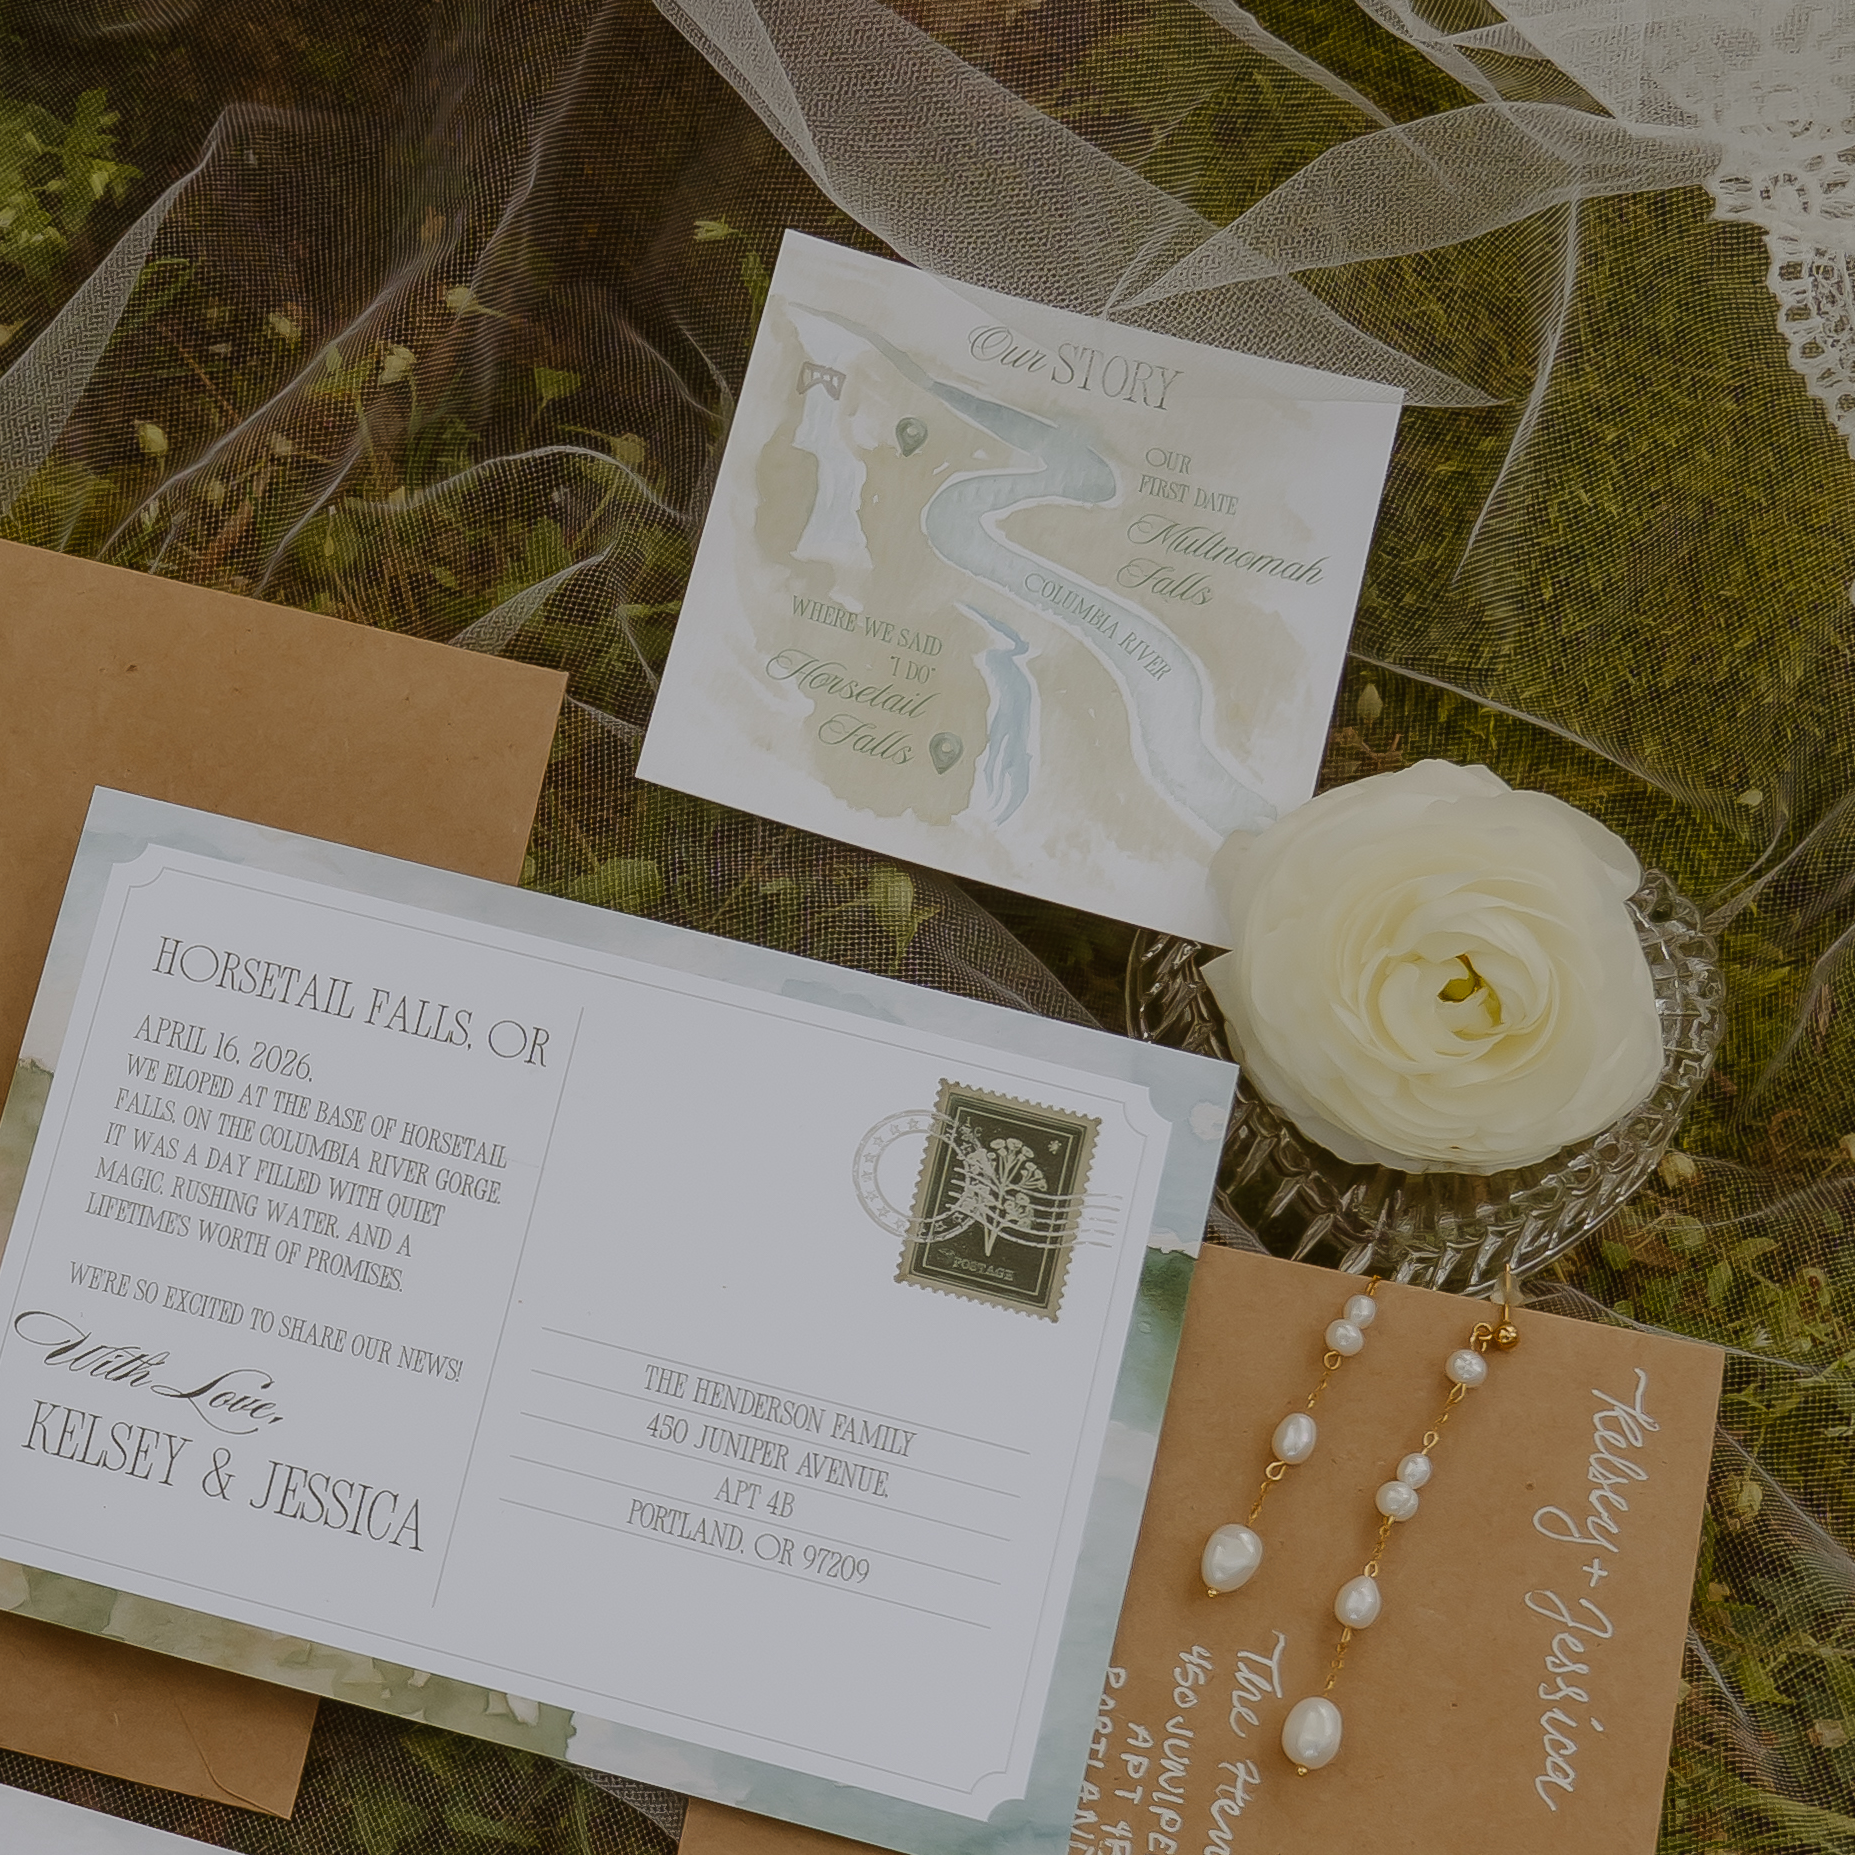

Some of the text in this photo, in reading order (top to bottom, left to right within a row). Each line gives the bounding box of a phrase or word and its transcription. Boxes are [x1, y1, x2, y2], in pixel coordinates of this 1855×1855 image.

[969, 323, 1185, 411] Our STORY
[1137, 473, 1240, 516] FIRST DATE
[1145, 447, 1192, 476] OUR
[1116, 557, 1214, 606] Falls
[1127, 513, 1331, 589] Multnomah
[792, 594, 943, 657] WHERE WE SAID
[1023, 572, 1173, 682] COLUMBIA RIVER
[765, 648, 942, 719] Horsetail
[817, 713, 915, 765] Falls
[132, 1014, 208, 1056] APRIL
[151, 935, 550, 1068] HORSETAIL FALLS, OR
[127, 1052, 508, 1169] WE ELOPED AT THE BASE OF HORSETAIL
[183, 1105, 214, 1131] ON
[217, 1112, 257, 1143] THE
[259, 1123, 360, 1170] COLUMBIA
[367, 1149, 430, 1187] RIVER
[103, 1121, 447, 1228] IT WAS A DAY FILLED WITH QUIET
[169, 1175, 260, 1217] RUSHING
[345, 1221, 393, 1251] AND
[395, 1233, 412, 1258] A
[198, 1218, 272, 1258] WORTH
[274, 1239, 303, 1265] OF
[951, 1255, 1015, 1282] POSTAGE
[12, 1309, 170, 1389] With
[132, 1278, 159, 1305] SO
[161, 1285, 245, 1325] EXCITED
[249, 1306, 275, 1334] TO
[277, 1314, 348, 1353] SHARE
[351, 1333, 393, 1366] OUR
[396, 1345, 464, 1383] NEWS!
[643, 1363, 918, 1458] THE HENDERSON FAMILY
[646, 1412, 689, 1445] 450
[692, 1423, 790, 1472] JUNIPER
[20, 1398, 425, 1553] KELSEY & JESSICA
[713, 1476, 796, 1519] APT 4B
[1532, 1367, 1662, 1554] Kelsey
[753, 1533, 795, 1567] OR
[802, 1544, 870, 1584] 97209
[1172, 1644, 1214, 1709] 450
[1228, 1629, 1288, 1738] The
[1523, 1589, 1617, 1812] Jessica
[1114, 1721, 1156, 1805] APT
